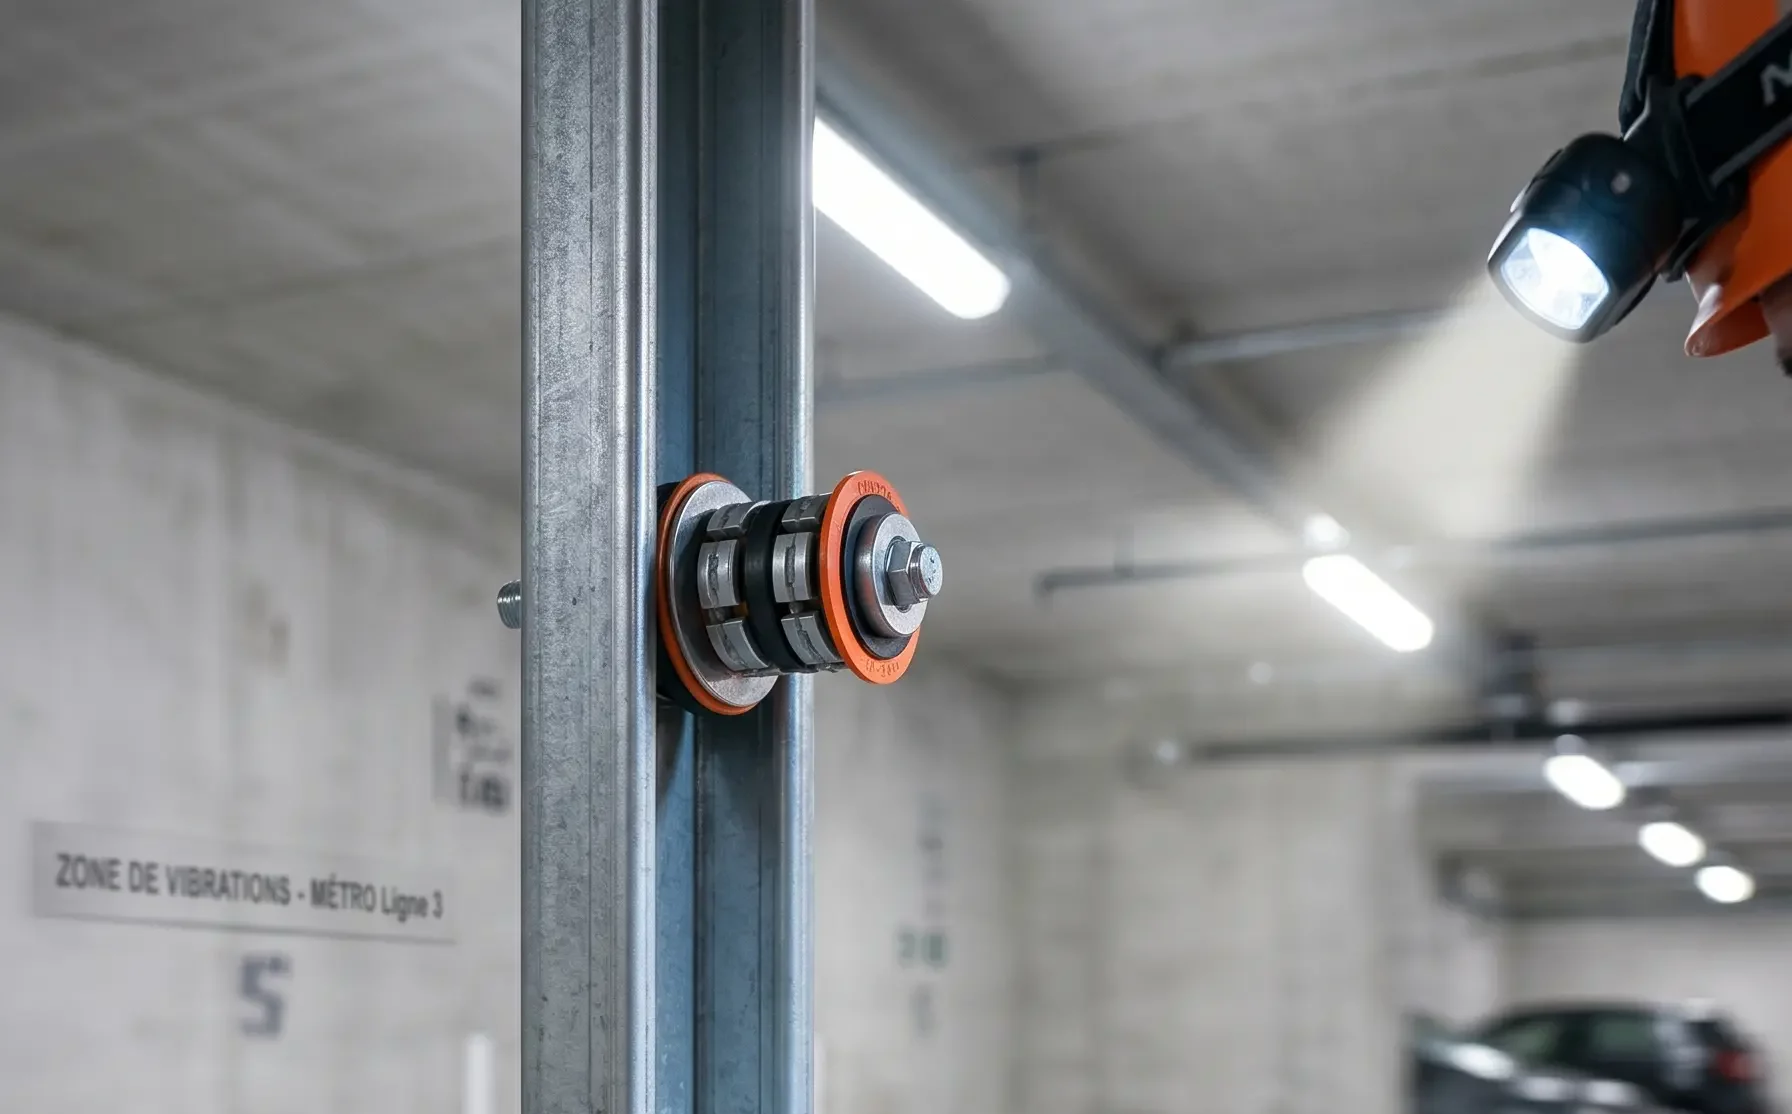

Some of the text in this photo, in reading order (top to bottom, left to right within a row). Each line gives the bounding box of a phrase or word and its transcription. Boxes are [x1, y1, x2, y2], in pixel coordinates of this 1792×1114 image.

[55, 852, 121, 891] ZONE
[128, 860, 160, 895] DE
[165, 865, 292, 906] VIBRATIONS
[310, 873, 377, 913] MÉTRO
[381, 886, 429, 923] Ligne
[433, 889, 444, 919] 3
